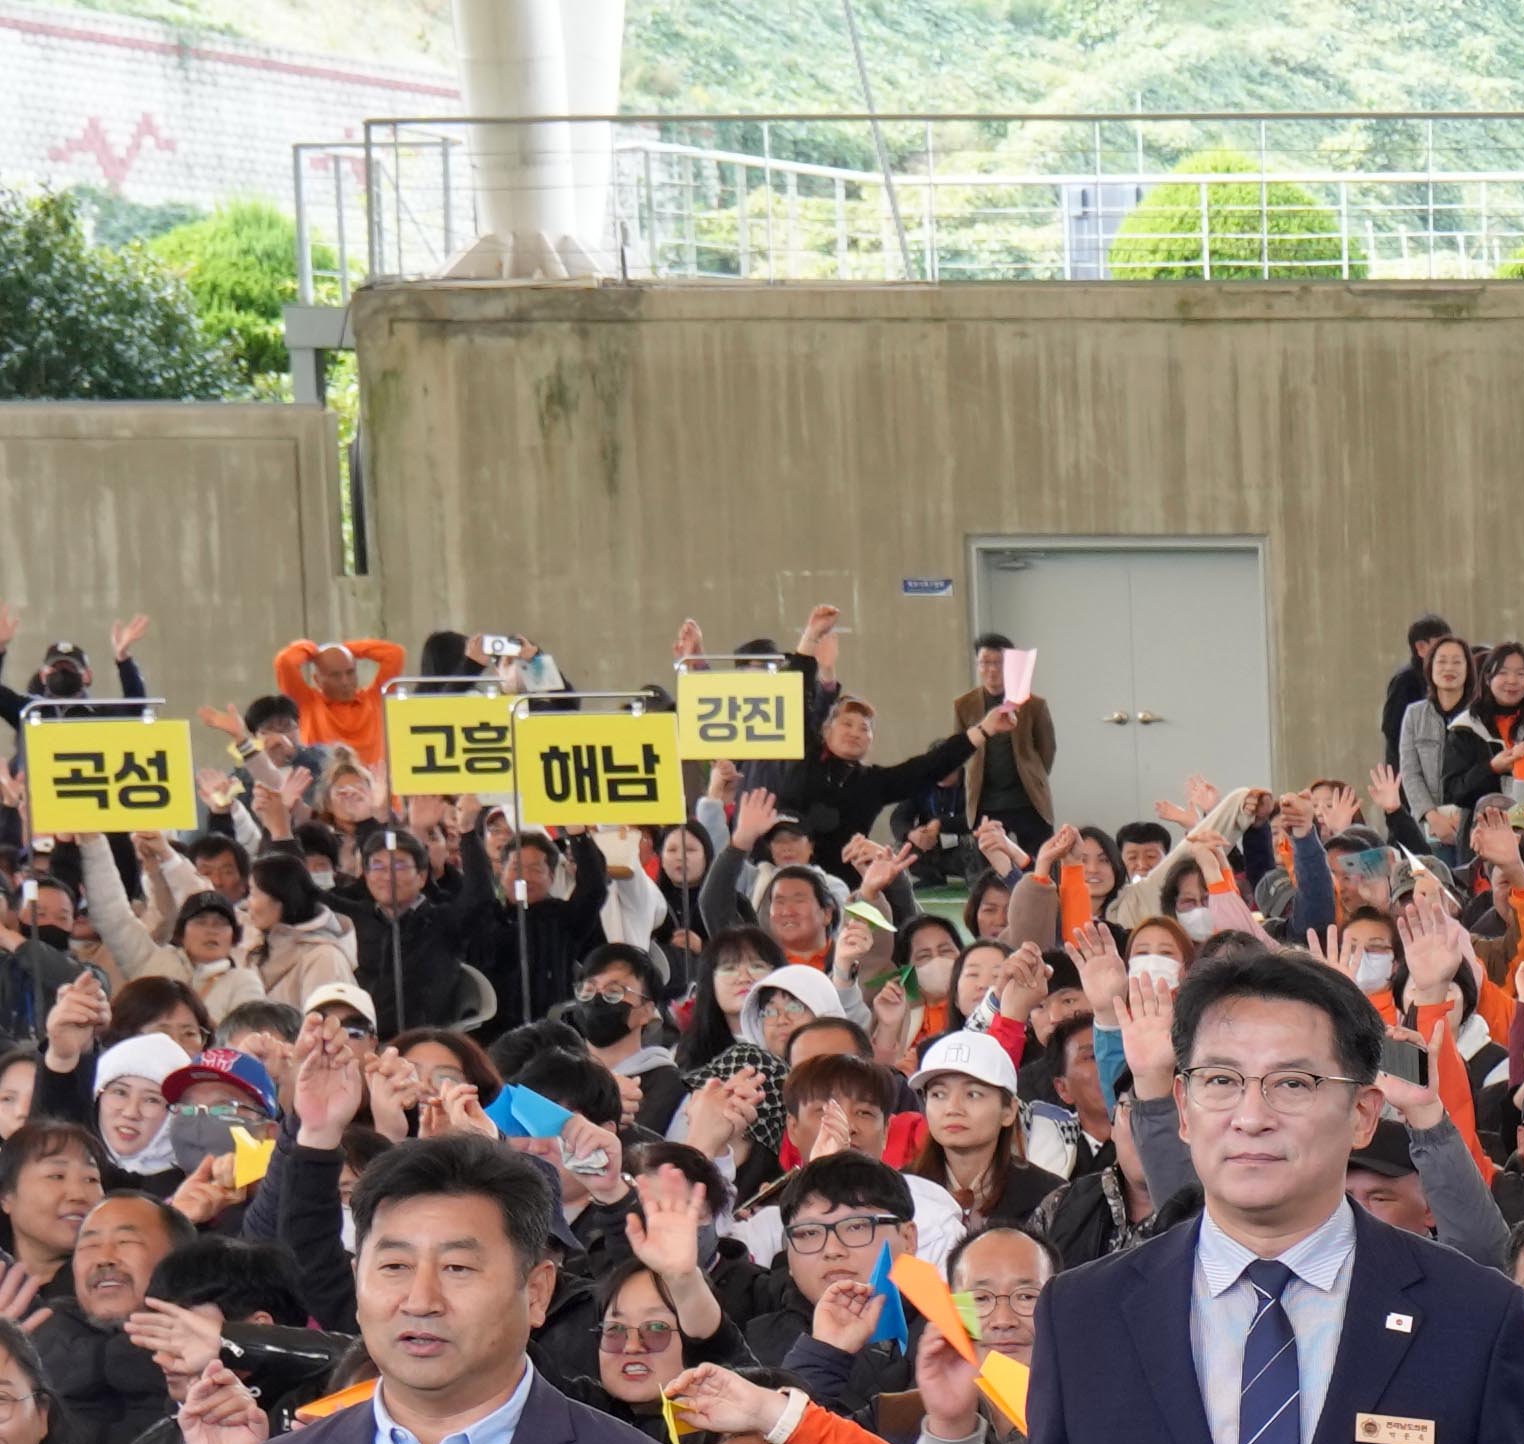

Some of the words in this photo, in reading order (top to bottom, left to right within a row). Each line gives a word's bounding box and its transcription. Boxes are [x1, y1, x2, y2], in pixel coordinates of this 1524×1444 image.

[696, 695, 787, 744] 강진
[411, 723, 511, 774] 고흥
[541, 744, 660, 803] 해남
[53, 750, 170, 809] 곡성
